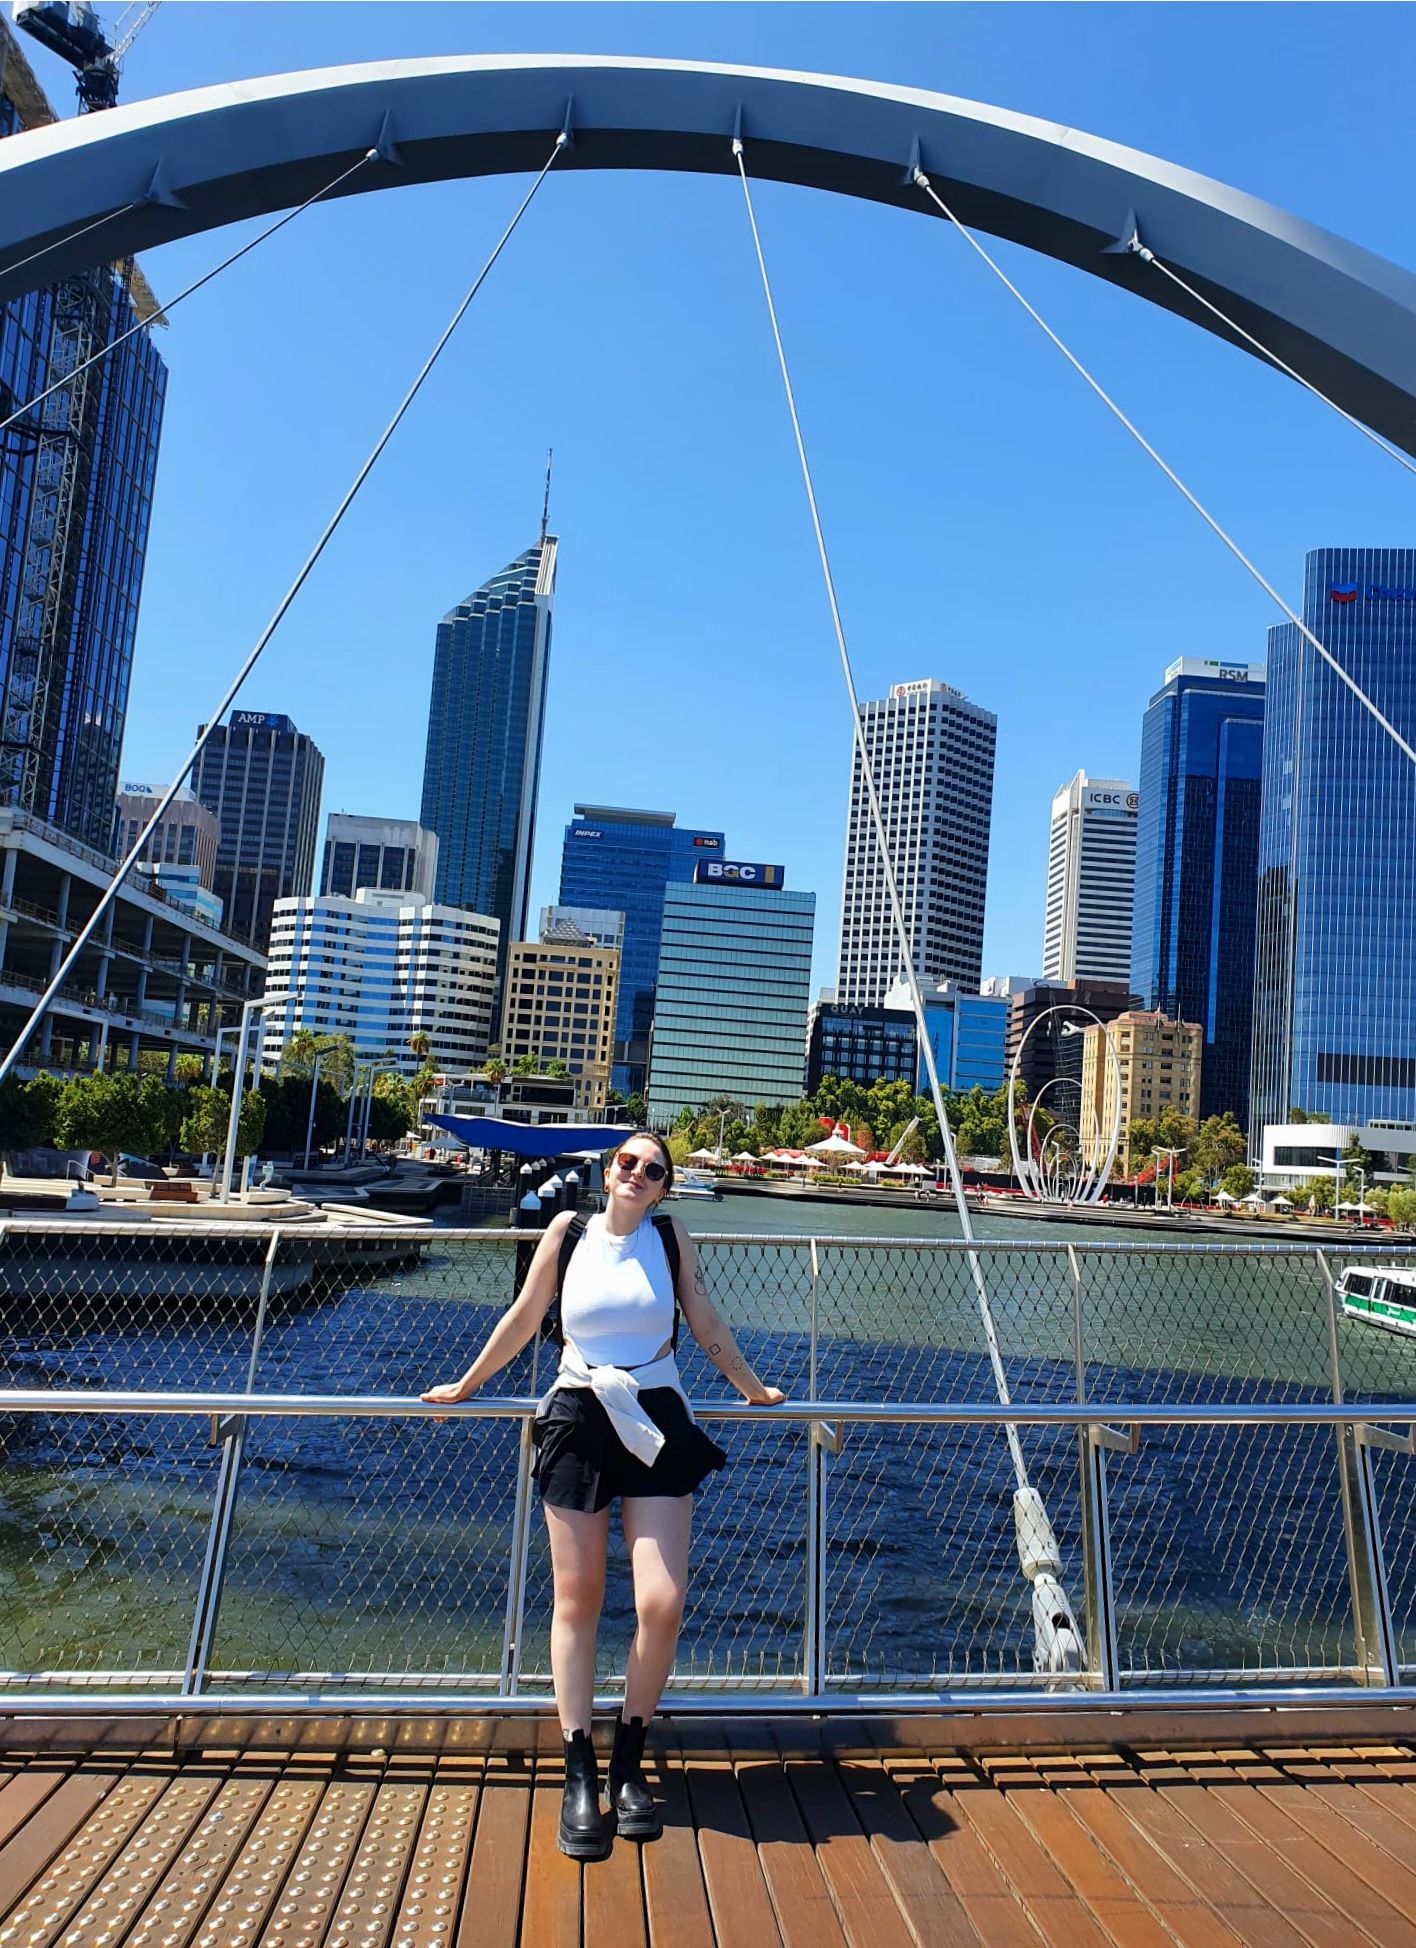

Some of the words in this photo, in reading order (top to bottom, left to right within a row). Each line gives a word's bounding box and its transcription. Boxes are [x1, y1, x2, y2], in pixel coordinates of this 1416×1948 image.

[1220, 669, 1248, 681] RSM
[238, 713, 265, 724] AMP
[125, 783, 146, 793] BOQ
[1090, 793, 1120, 804] ICBC
[575, 830, 601, 838] INPEX
[704, 839, 718, 847] nab
[707, 863, 756, 880] BGC
[830, 1005, 864, 1015] QUAY
